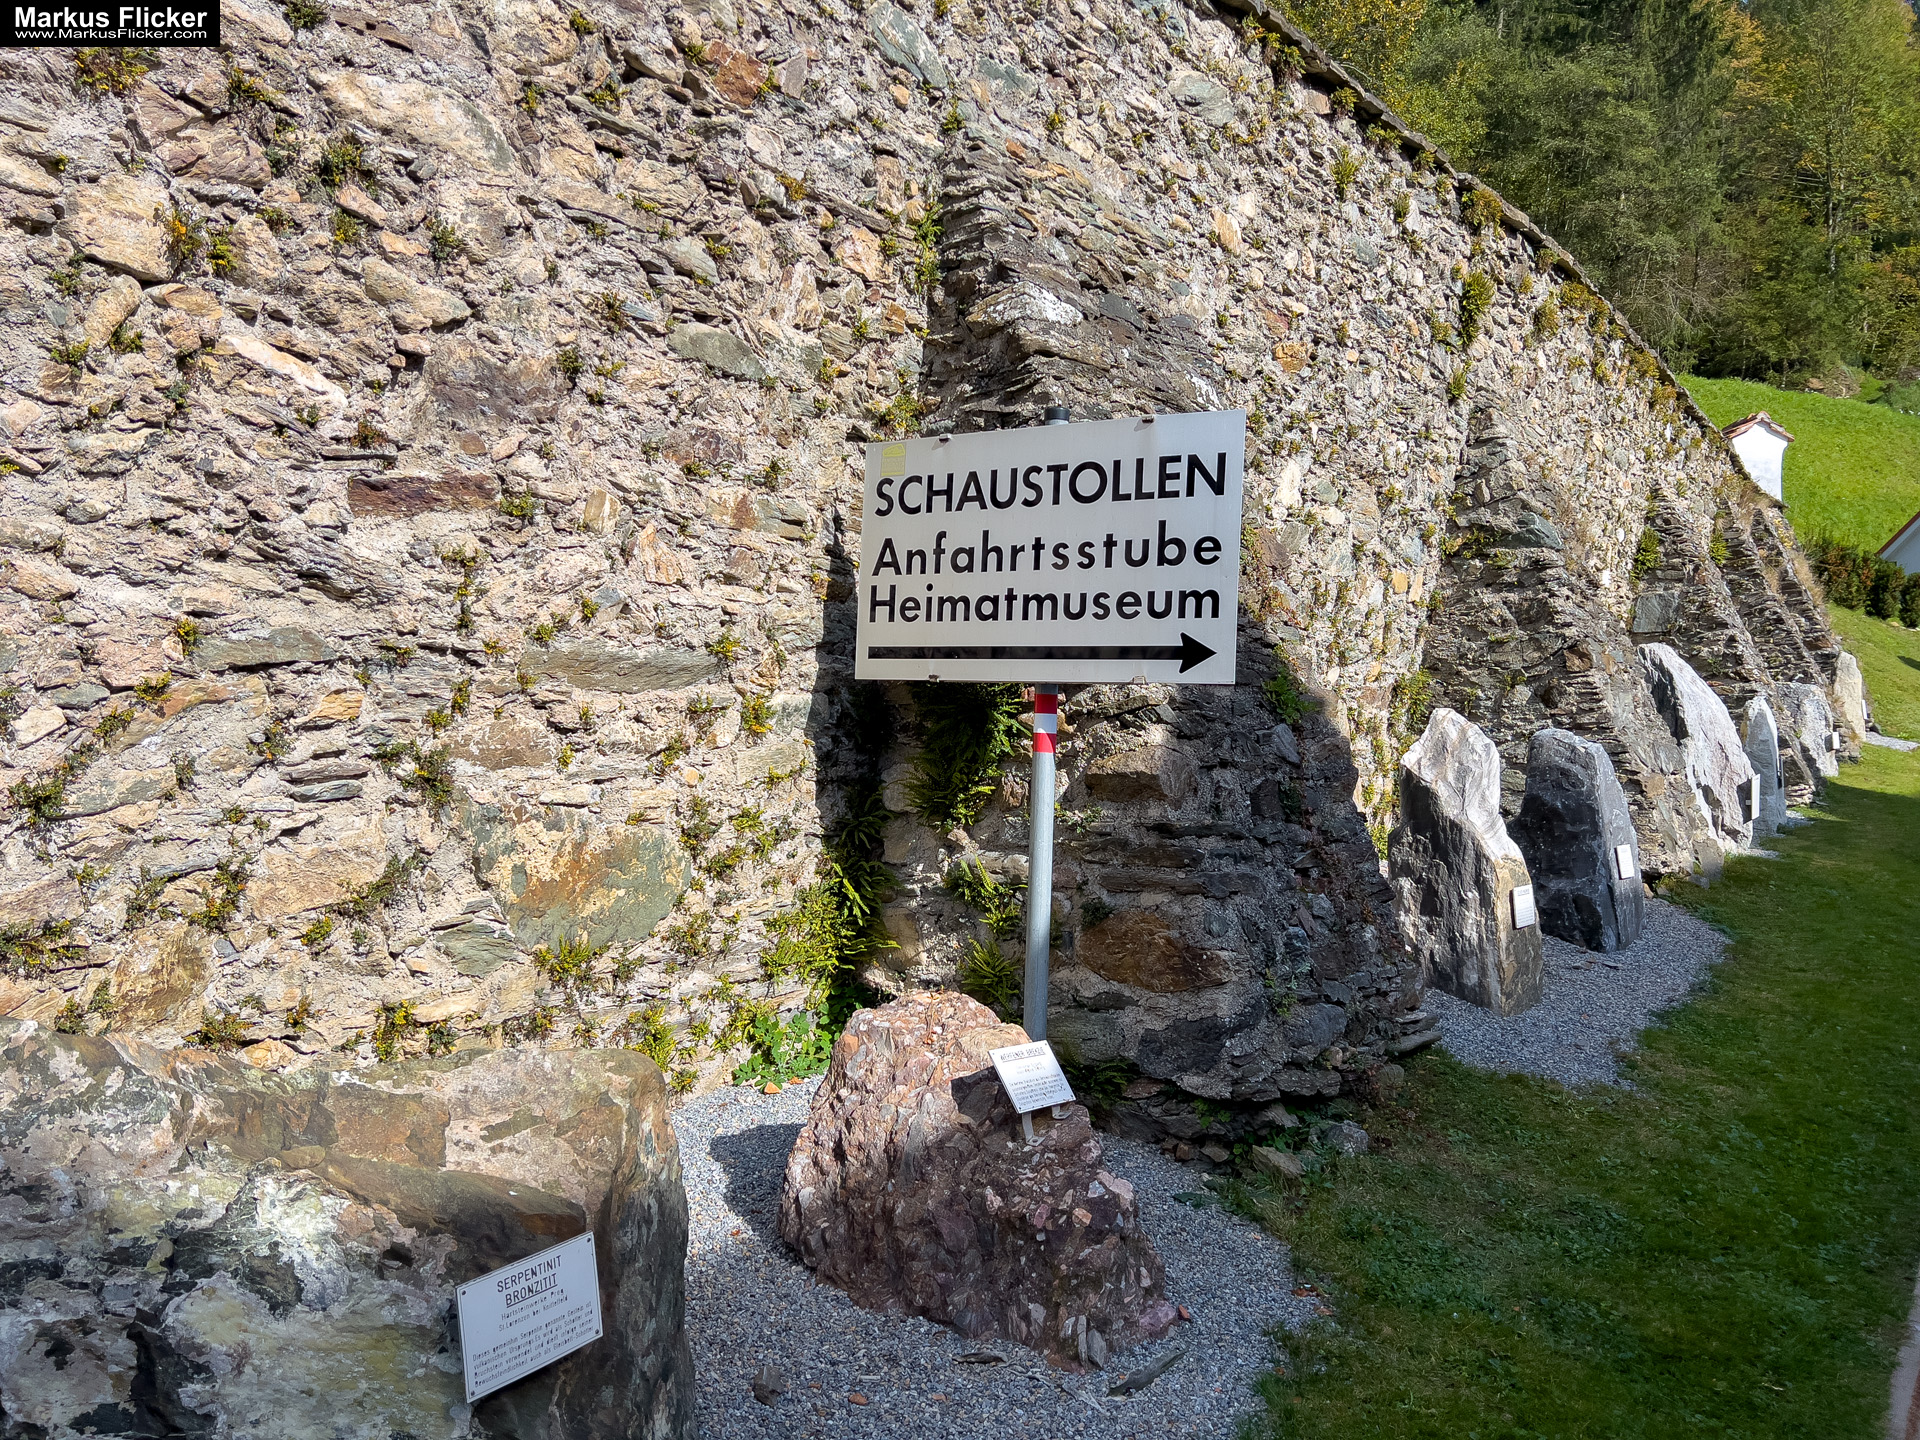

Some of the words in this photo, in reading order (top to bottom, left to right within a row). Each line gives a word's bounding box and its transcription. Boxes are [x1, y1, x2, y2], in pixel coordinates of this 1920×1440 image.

[874, 452, 1226, 517] SCHAUSTOLLEN
[872, 520, 1222, 577] Anfahrtsstube
[869, 584, 1220, 623] Heimatmuseum
[496, 1254, 562, 1293] SERPENTINIT
[504, 1272, 557, 1306] BRONZITIT
[501, 1294, 547, 1321] Hartsteinwerke
[472, 1346, 490, 1362] Dieses
